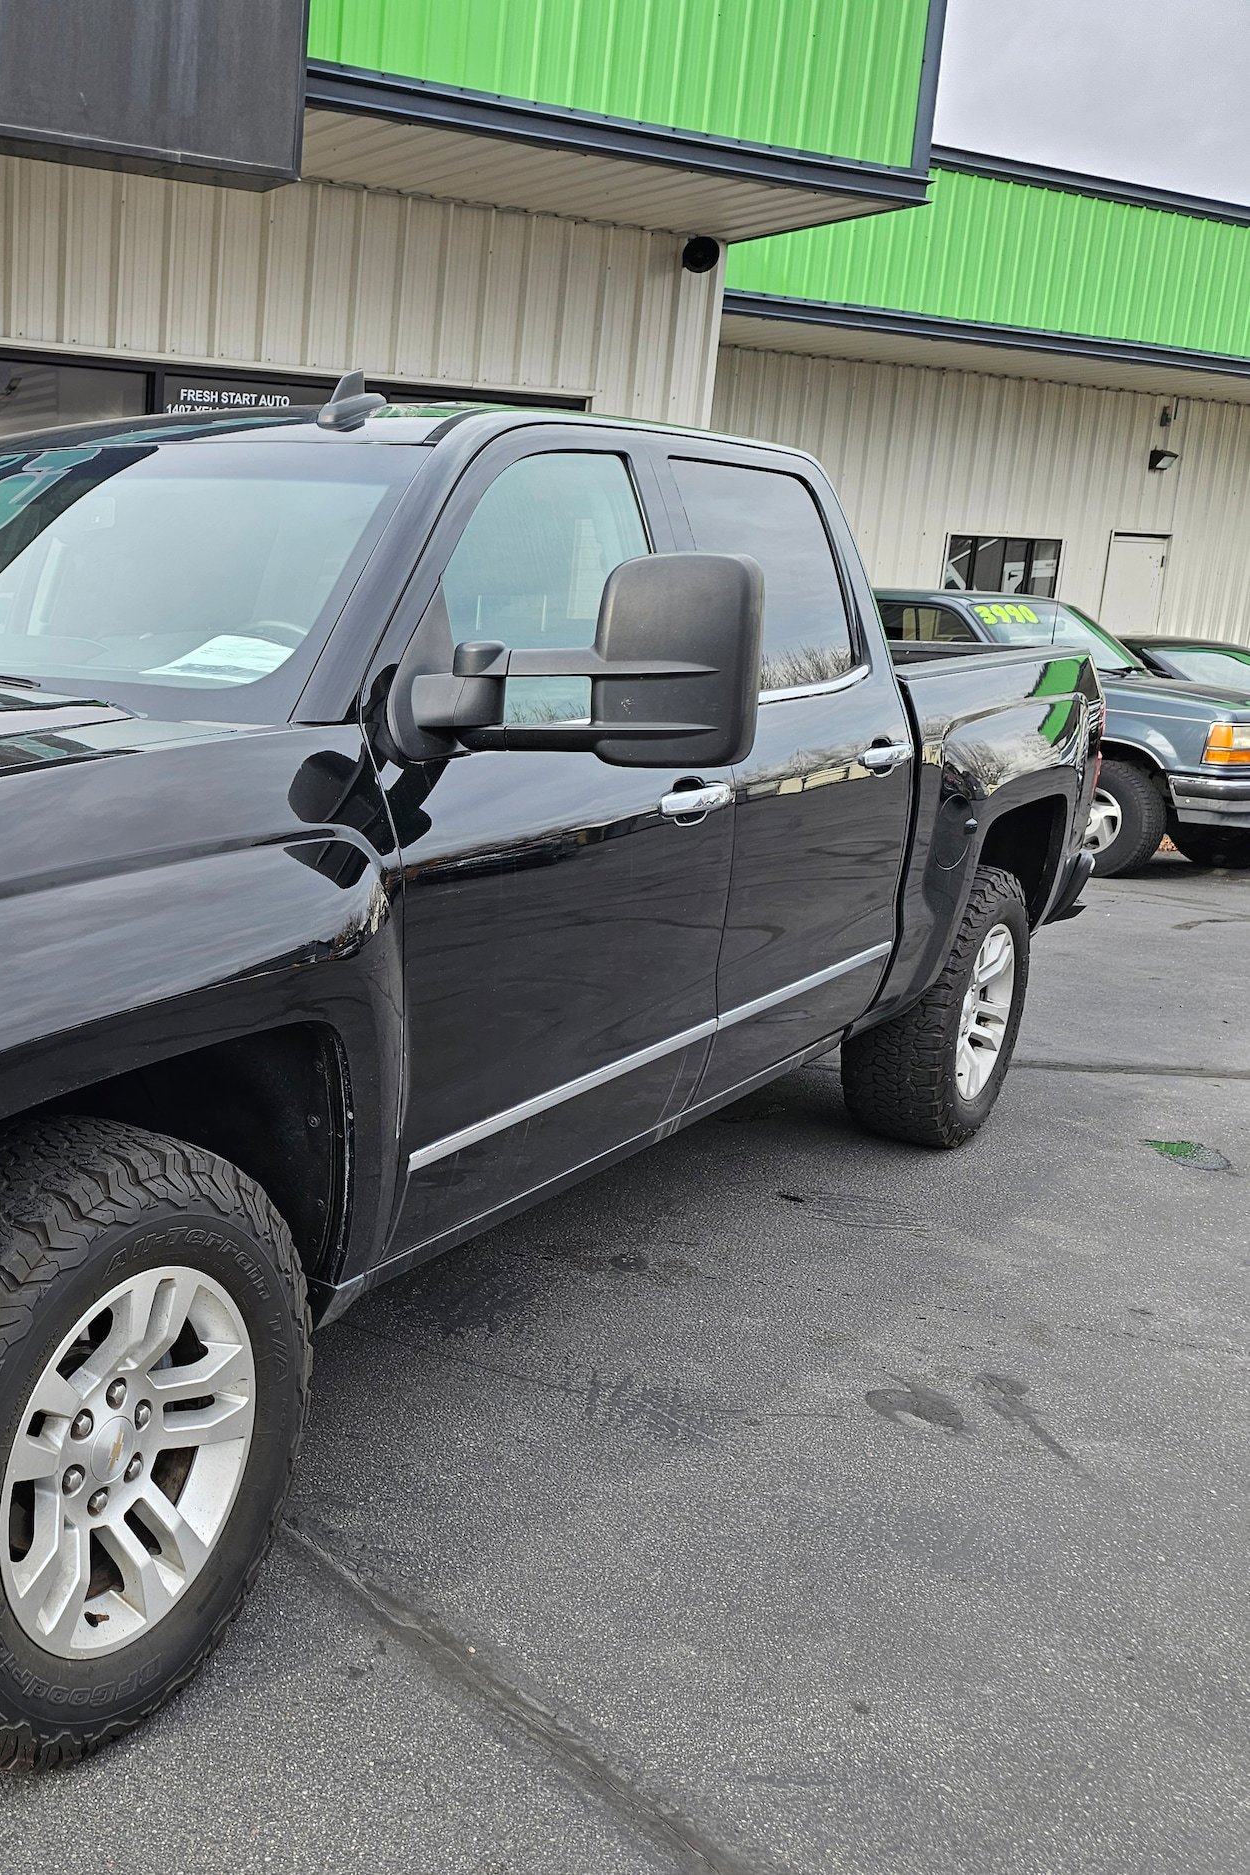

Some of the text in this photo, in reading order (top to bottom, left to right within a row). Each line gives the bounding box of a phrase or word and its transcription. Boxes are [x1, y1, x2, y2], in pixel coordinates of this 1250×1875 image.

[180, 388, 291, 407] FRESH START AUTO
[974, 604, 1040, 625] 3990
[101, 1225, 272, 1302] All-Terrain
